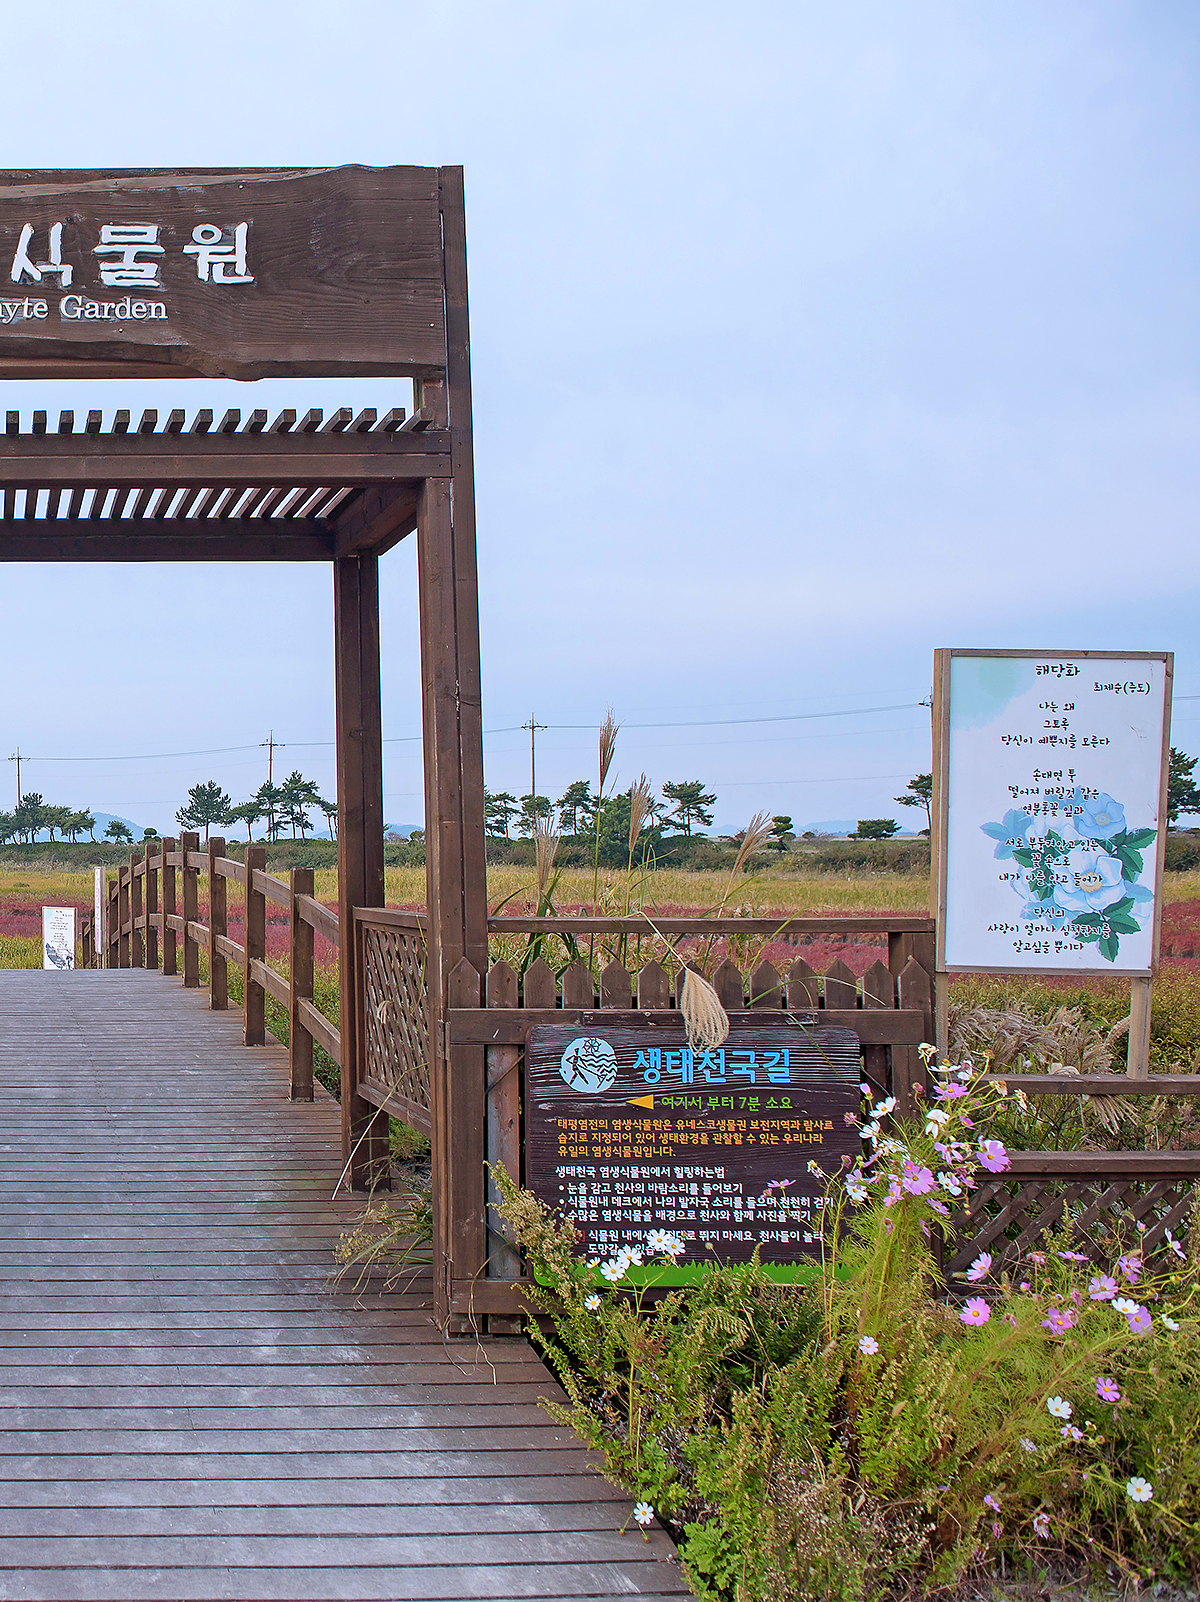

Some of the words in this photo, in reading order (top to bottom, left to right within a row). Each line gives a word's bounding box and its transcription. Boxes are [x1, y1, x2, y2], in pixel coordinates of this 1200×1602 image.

[61, 296, 169, 321] Garden
[1036, 663, 1080, 678] 해당화
[1039, 702, 1058, 713] 나는
[1063, 702, 1075, 711] 왜
[1043, 717, 1070, 731] 그토록
[1001, 735, 1033, 746] 당신이
[1038, 734, 1077, 749] 예쁜지를
[1082, 735, 1111, 748] 모른다
[1008, 785, 1040, 799] 떨어져
[1044, 787, 1075, 800] 버릴것
[1081, 787, 1100, 800] 같은
[1005, 837, 1024, 848] 서로
[1081, 840, 1099, 852] 있는
[1046, 854, 1070, 868] 속으로
[998, 873, 1021, 882] 내가
[1025, 870, 1045, 886] 나를
[1073, 872, 1103, 886] 들어가
[1034, 907, 1065, 918] 당신의
[987, 923, 1019, 934] 사랑이
[1024, 923, 1056, 936] 얼마나
[1013, 940, 1050, 954] 알고싶을
[1054, 941, 1084, 954] 뿐이다
[633, 1048, 792, 1084] 생태천국길
[661, 1096, 702, 1110] 여기서
[707, 1096, 734, 1111] 부터
[739, 1096, 761, 1112] 7분
[765, 1096, 793, 1109] 소요
[558, 1119, 608, 1131] 태평염전의
[612, 1119, 673, 1131] 염생식물원은
[676, 1119, 747, 1132] 유네스코생물권
[749, 1120, 801, 1132] 보전지역과
[803, 1120, 834, 1132] 람사르
[558, 1132, 589, 1145] 습지로
[592, 1132, 632, 1145] 지정되어
[635, 1132, 656, 1144] 있어
[658, 1132, 710, 1145] 생태환경을
[712, 1133, 743, 1145] 관찰할
[746, 1133, 757, 1145] 수
[760, 1133, 780, 1145] 있는
[782, 1133, 824, 1145] 우리나라
[558, 1146, 589, 1158] 유일의
[592, 1146, 676, 1158] 염생식물원입니다.
[555, 1166, 597, 1179] 생태천국
[599, 1166, 671, 1179] 염생식물원에서
[673, 1166, 725, 1179] 힐링하는법
[567, 1182, 588, 1195] 눈을
[591, 1182, 612, 1195] 감고
[614, 1182, 645, 1194] 천사의
[647, 1182, 700, 1195] 바람소리를
[702, 1183, 743, 1196] 들어보기
[568, 1196, 609, 1208] 식물원내
[611, 1196, 653, 1208] 데크에서
[655, 1196, 676, 1208] 나의
[678, 1196, 710, 1209] 발자국
[712, 1197, 744, 1209] 소리를
[745, 1197, 777, 1209] 들으며
[779, 1197, 811, 1209] 천천히
[813, 1197, 834, 1209] 걷기
[567, 1209, 599, 1222] 수많은
[601, 1209, 653, 1222] 염생식물을
[655, 1209, 697, 1222] 배경으로
[699, 1210, 731, 1222] 천사와
[732, 1210, 754, 1222] 함께
[756, 1210, 788, 1222] 사진을
[588, 1230, 619, 1242] 식물원
[699, 1230, 720, 1242] 뛰지
[722, 1230, 756, 1242] 마세요.
[759, 1230, 800, 1243] 천사들이
